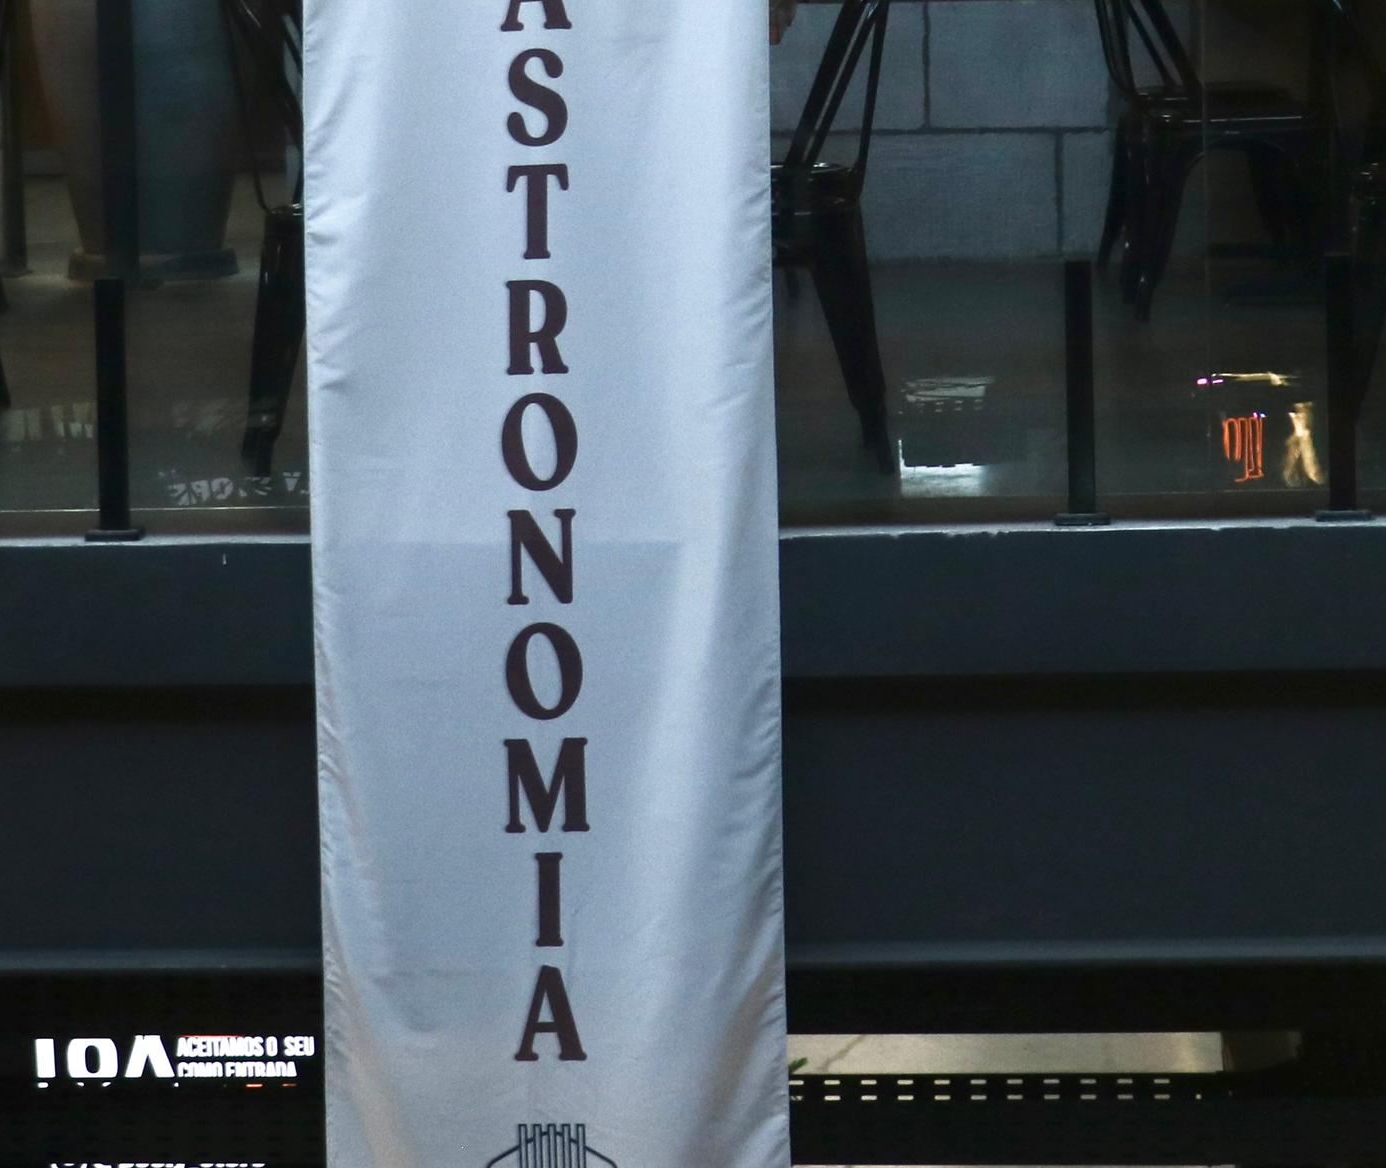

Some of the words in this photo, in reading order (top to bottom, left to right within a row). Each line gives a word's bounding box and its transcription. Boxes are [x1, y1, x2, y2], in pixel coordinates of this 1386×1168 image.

[177, 1036, 264, 1057] ACEITAMOS
[266, 1036, 278, 1057] O
[284, 1035, 315, 1056] SEU
